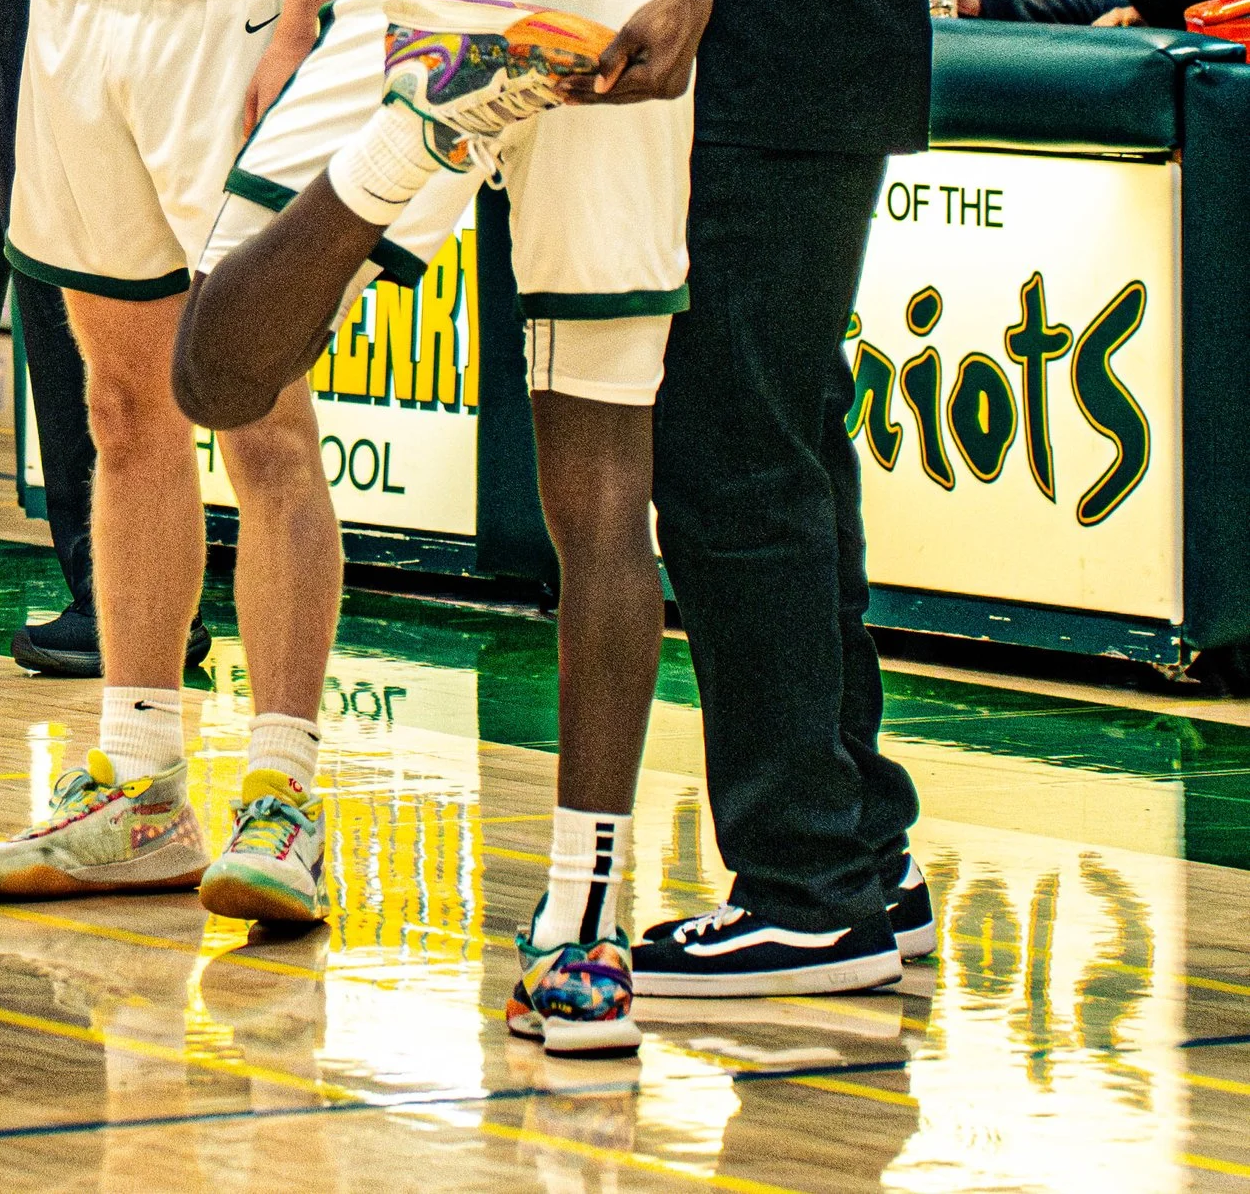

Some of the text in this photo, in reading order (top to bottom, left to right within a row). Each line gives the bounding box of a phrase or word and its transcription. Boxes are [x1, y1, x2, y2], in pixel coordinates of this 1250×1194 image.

[887, 181, 1004, 228] OF THE
[844, 270, 1151, 528] riots
